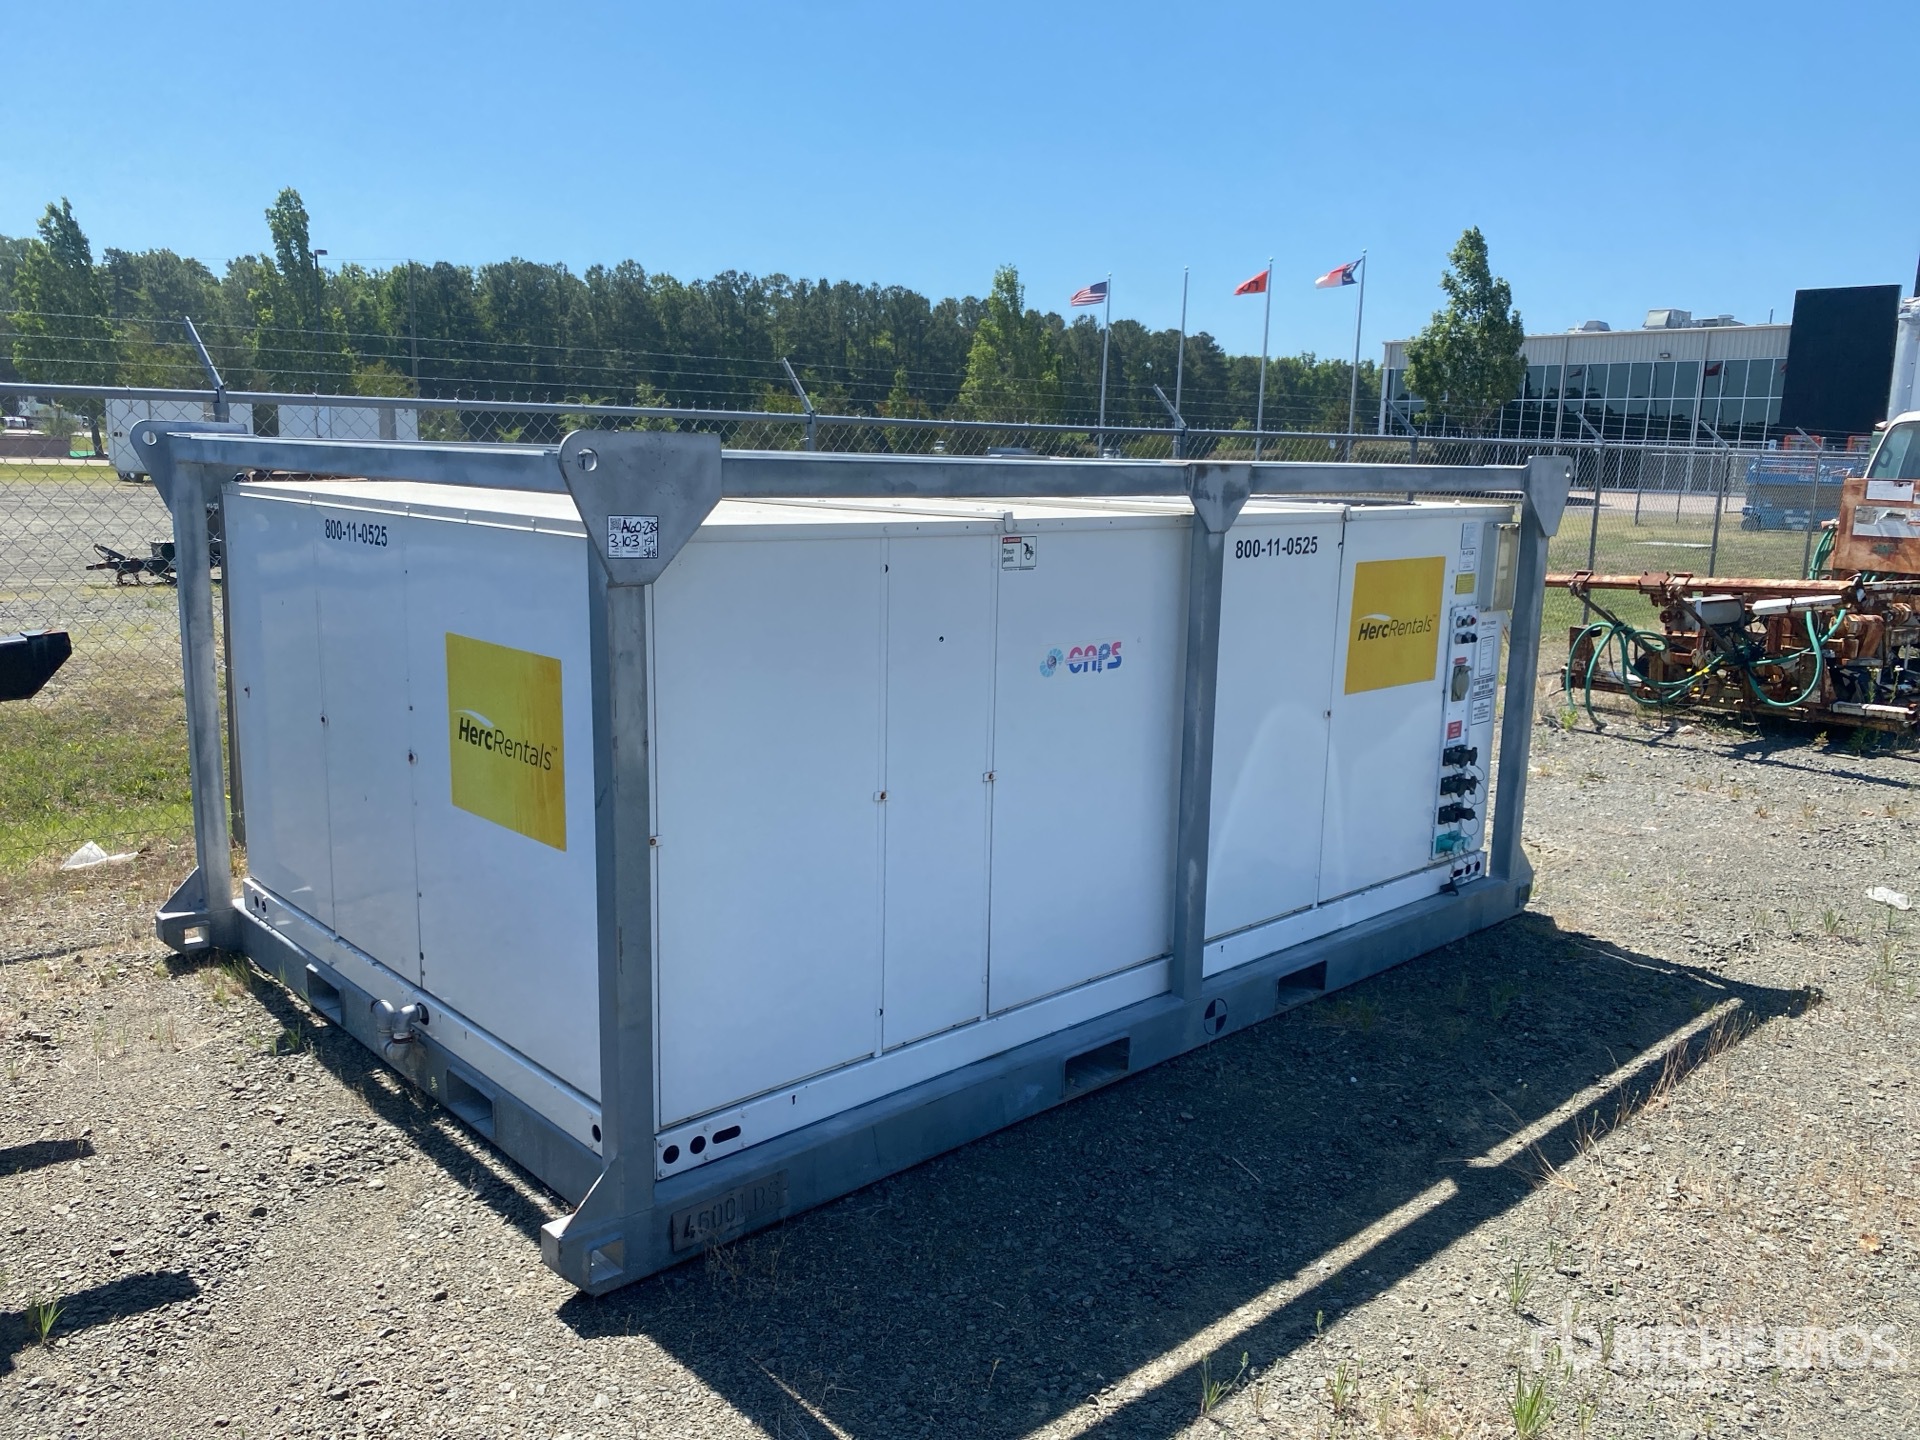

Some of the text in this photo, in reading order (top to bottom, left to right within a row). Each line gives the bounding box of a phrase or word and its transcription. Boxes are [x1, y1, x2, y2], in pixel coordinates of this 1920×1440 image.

[325, 518, 388, 547] 800-11-0525
[1235, 536, 1318, 559] 800-11-0525
[1357, 615, 1433, 641] HercRentals
[458, 717, 552, 771] HercRentals
